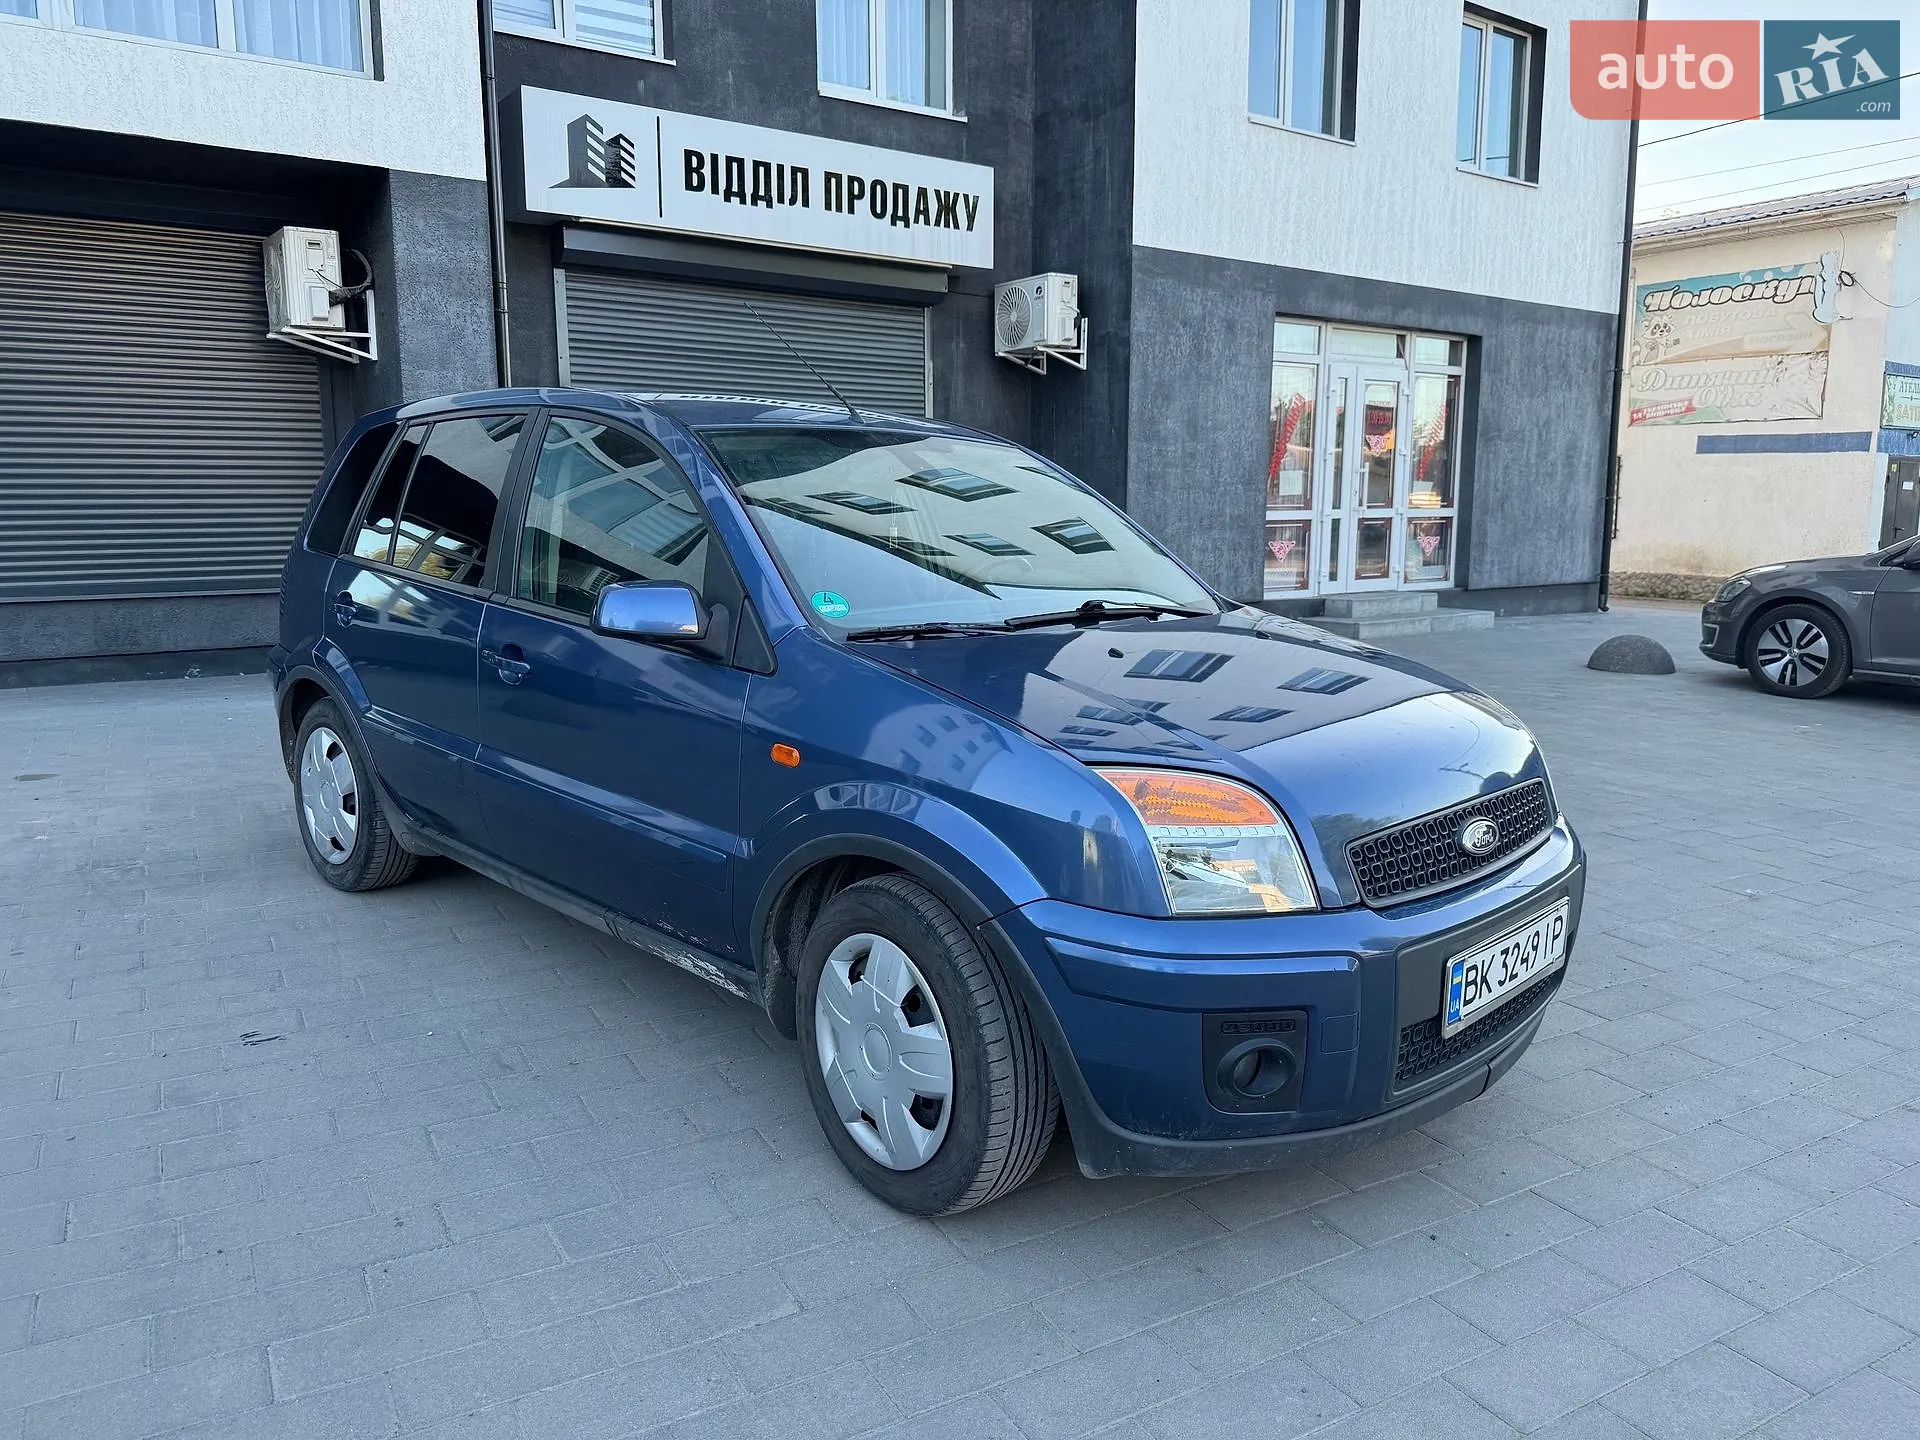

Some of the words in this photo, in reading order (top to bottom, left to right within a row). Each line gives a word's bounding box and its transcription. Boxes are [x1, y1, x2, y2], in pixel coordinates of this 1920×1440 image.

[682, 148, 811, 210] ВІДДІЛ
[823, 170, 980, 232] ПРОДАЖУ
[1450, 998, 1460, 1013] UA
[1463, 954, 1495, 1008] BK
[1498, 929, 1540, 988] 3249
